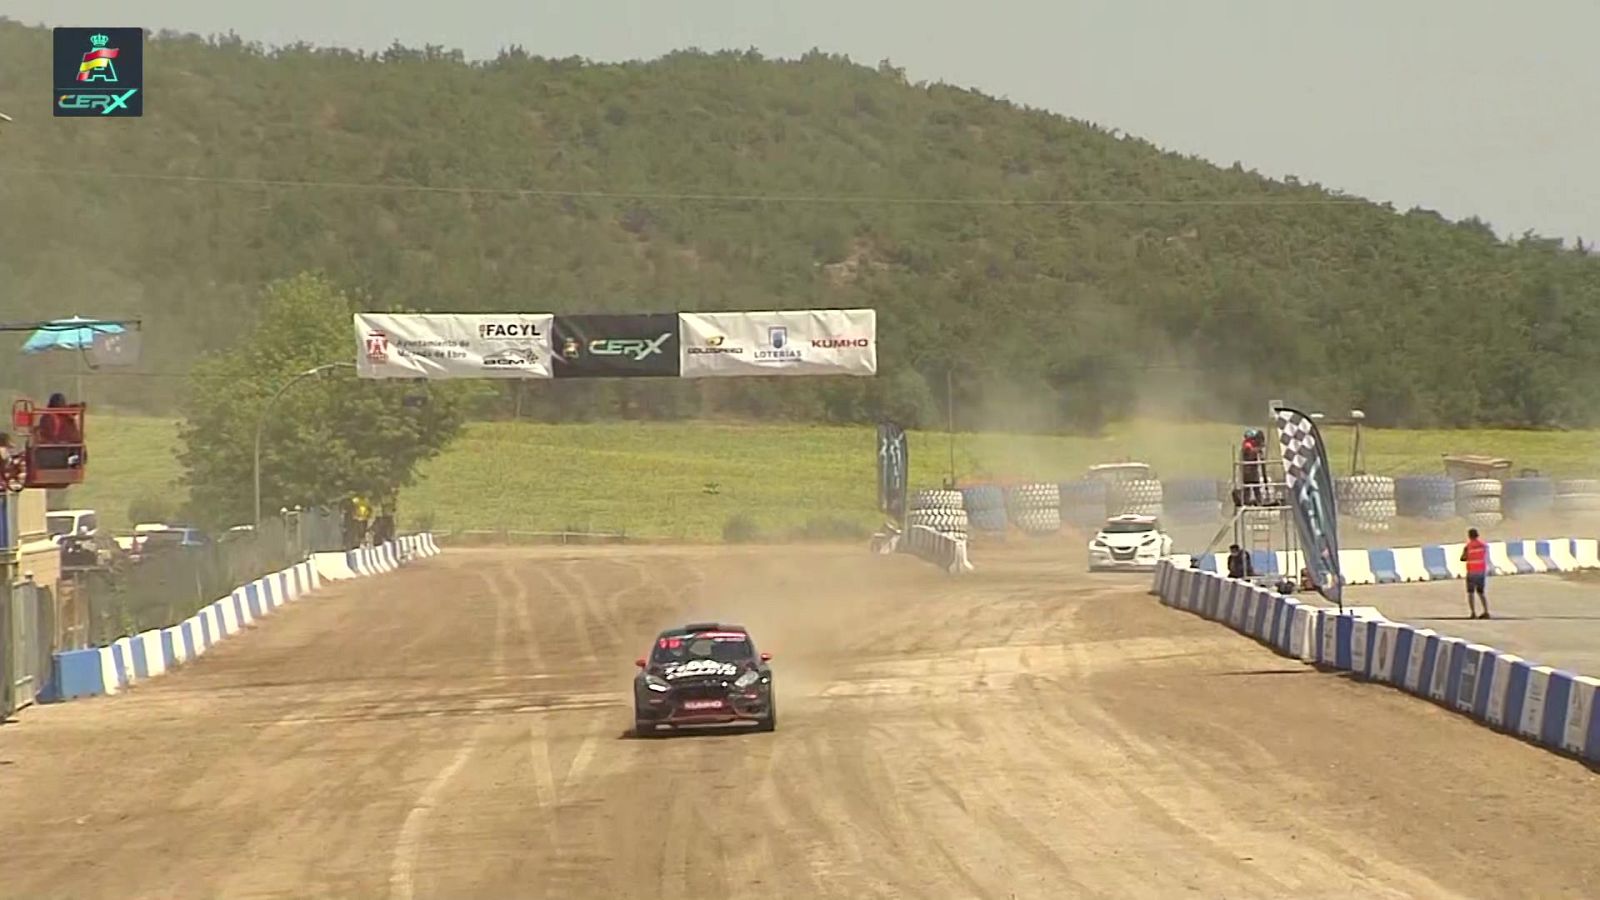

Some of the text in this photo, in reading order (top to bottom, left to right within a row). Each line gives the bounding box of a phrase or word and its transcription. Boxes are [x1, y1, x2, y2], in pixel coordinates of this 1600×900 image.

[486, 324, 541, 336] FACYL
[588, 333, 672, 361] CERX
[811, 338, 869, 349] KUMHO
